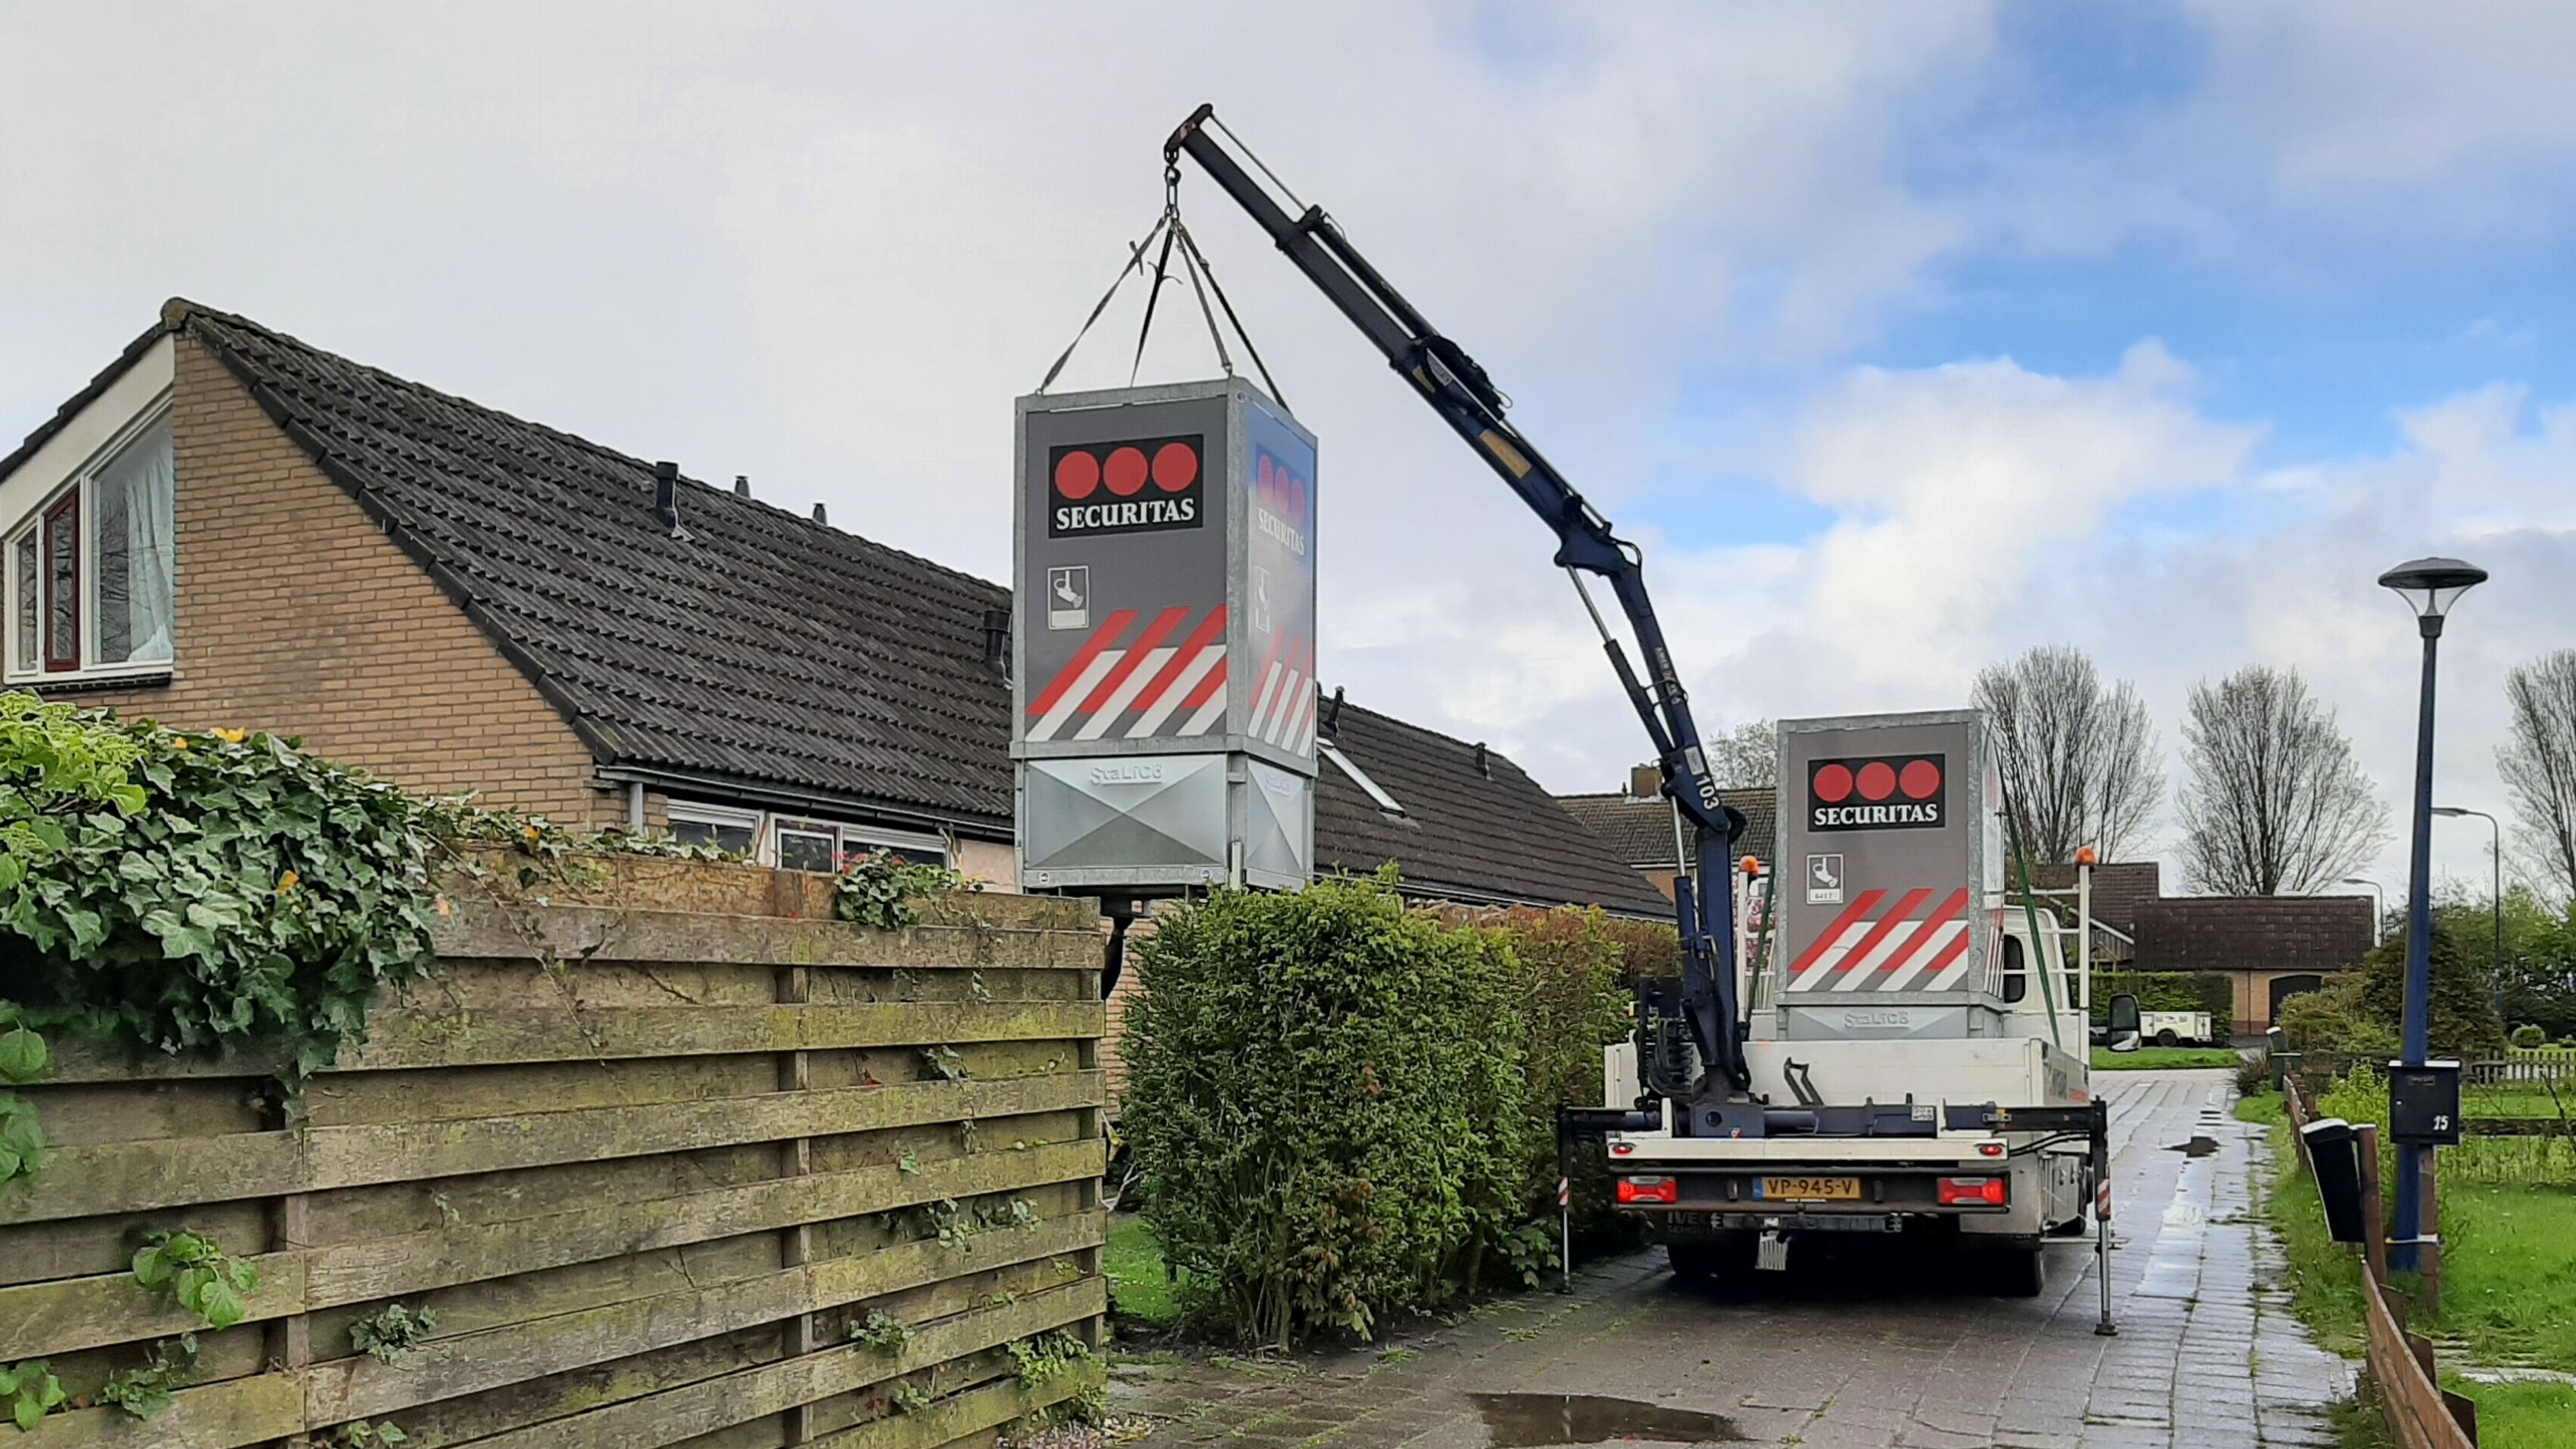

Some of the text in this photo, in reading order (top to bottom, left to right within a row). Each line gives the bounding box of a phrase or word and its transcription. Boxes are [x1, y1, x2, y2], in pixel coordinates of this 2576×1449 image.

[1056, 498, 1195, 530] SECURITAS
[1257, 507, 1305, 556] SECURITAS
[1696, 775, 1720, 810] 103
[1814, 803, 1939, 826] SECURITAS
[2433, 1115, 2450, 1131] 15
[1767, 1178, 1853, 1195] VP-945-V
[1667, 1210, 1711, 1225] IVEC
